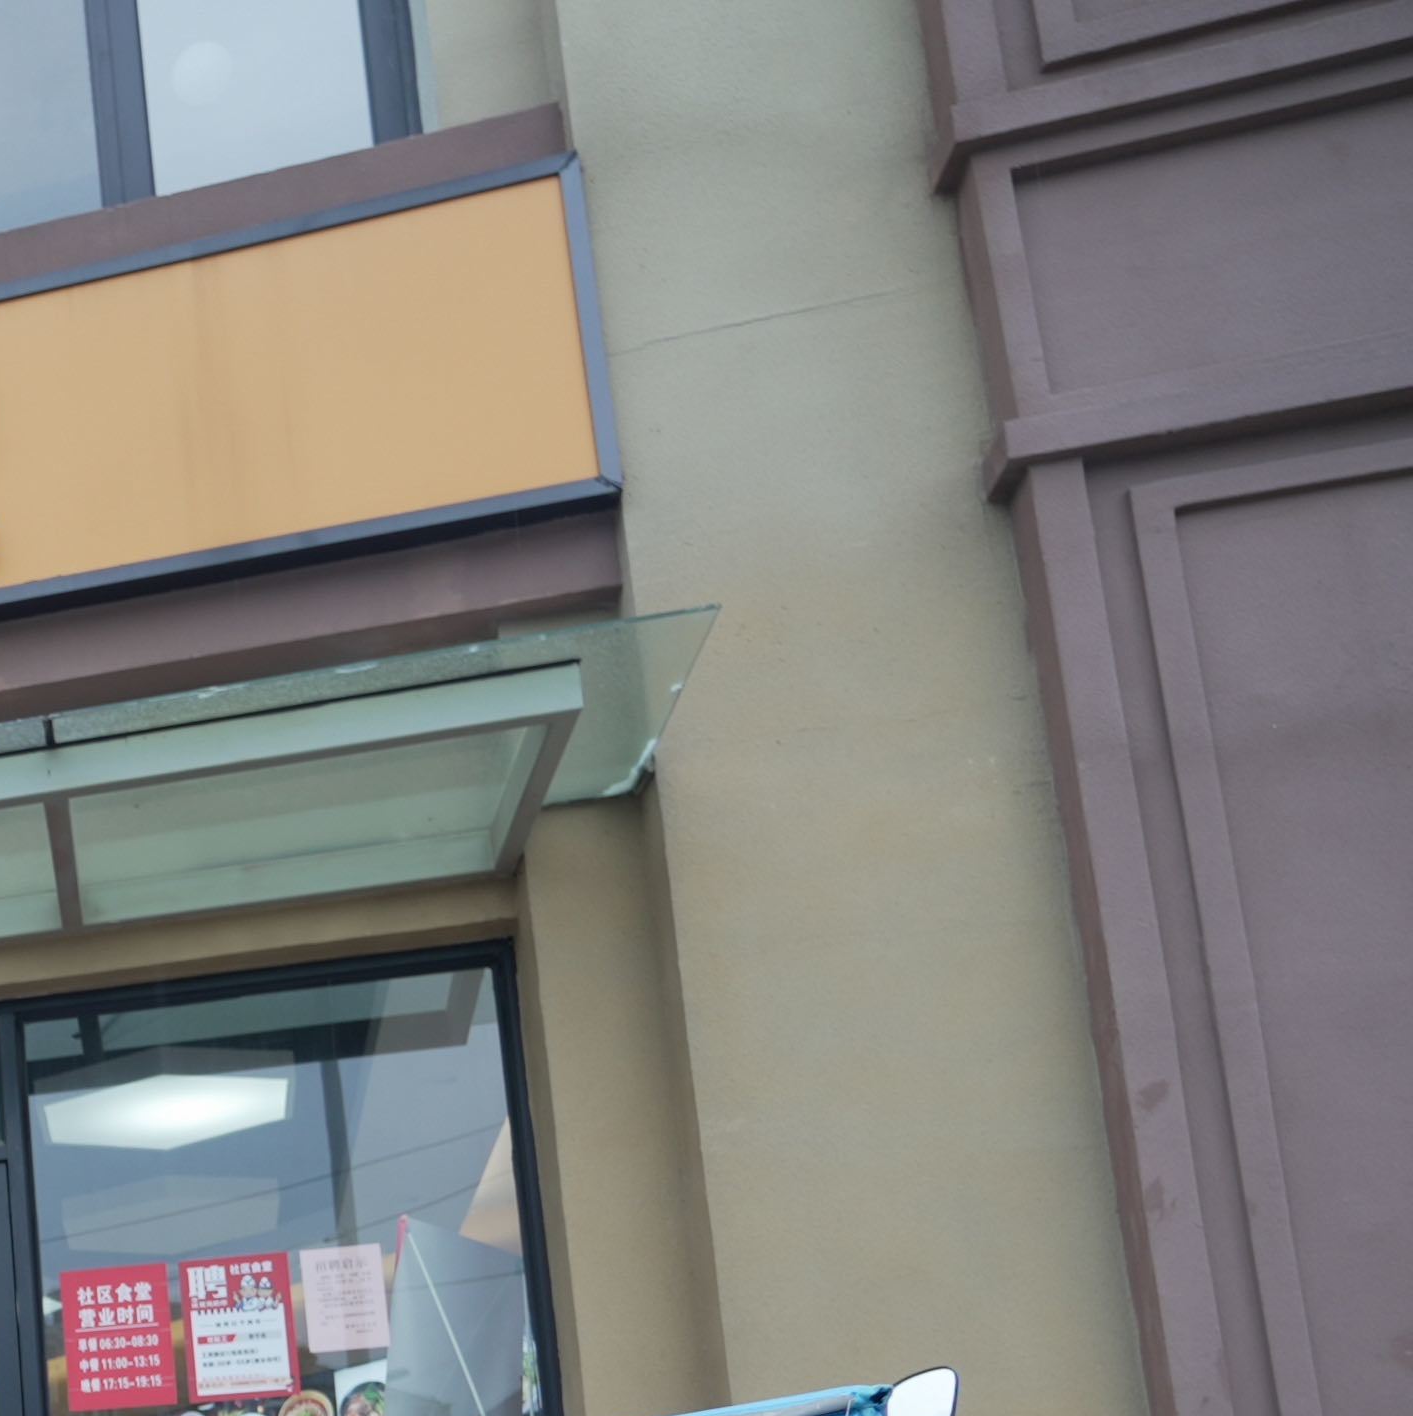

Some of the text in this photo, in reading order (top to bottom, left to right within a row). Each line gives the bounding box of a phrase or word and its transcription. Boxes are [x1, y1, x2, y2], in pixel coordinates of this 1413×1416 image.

[77, 1281, 152, 1306] 社区食堂
[186, 1265, 228, 1300] 聘
[78, 1304, 154, 1329] 营业时间
